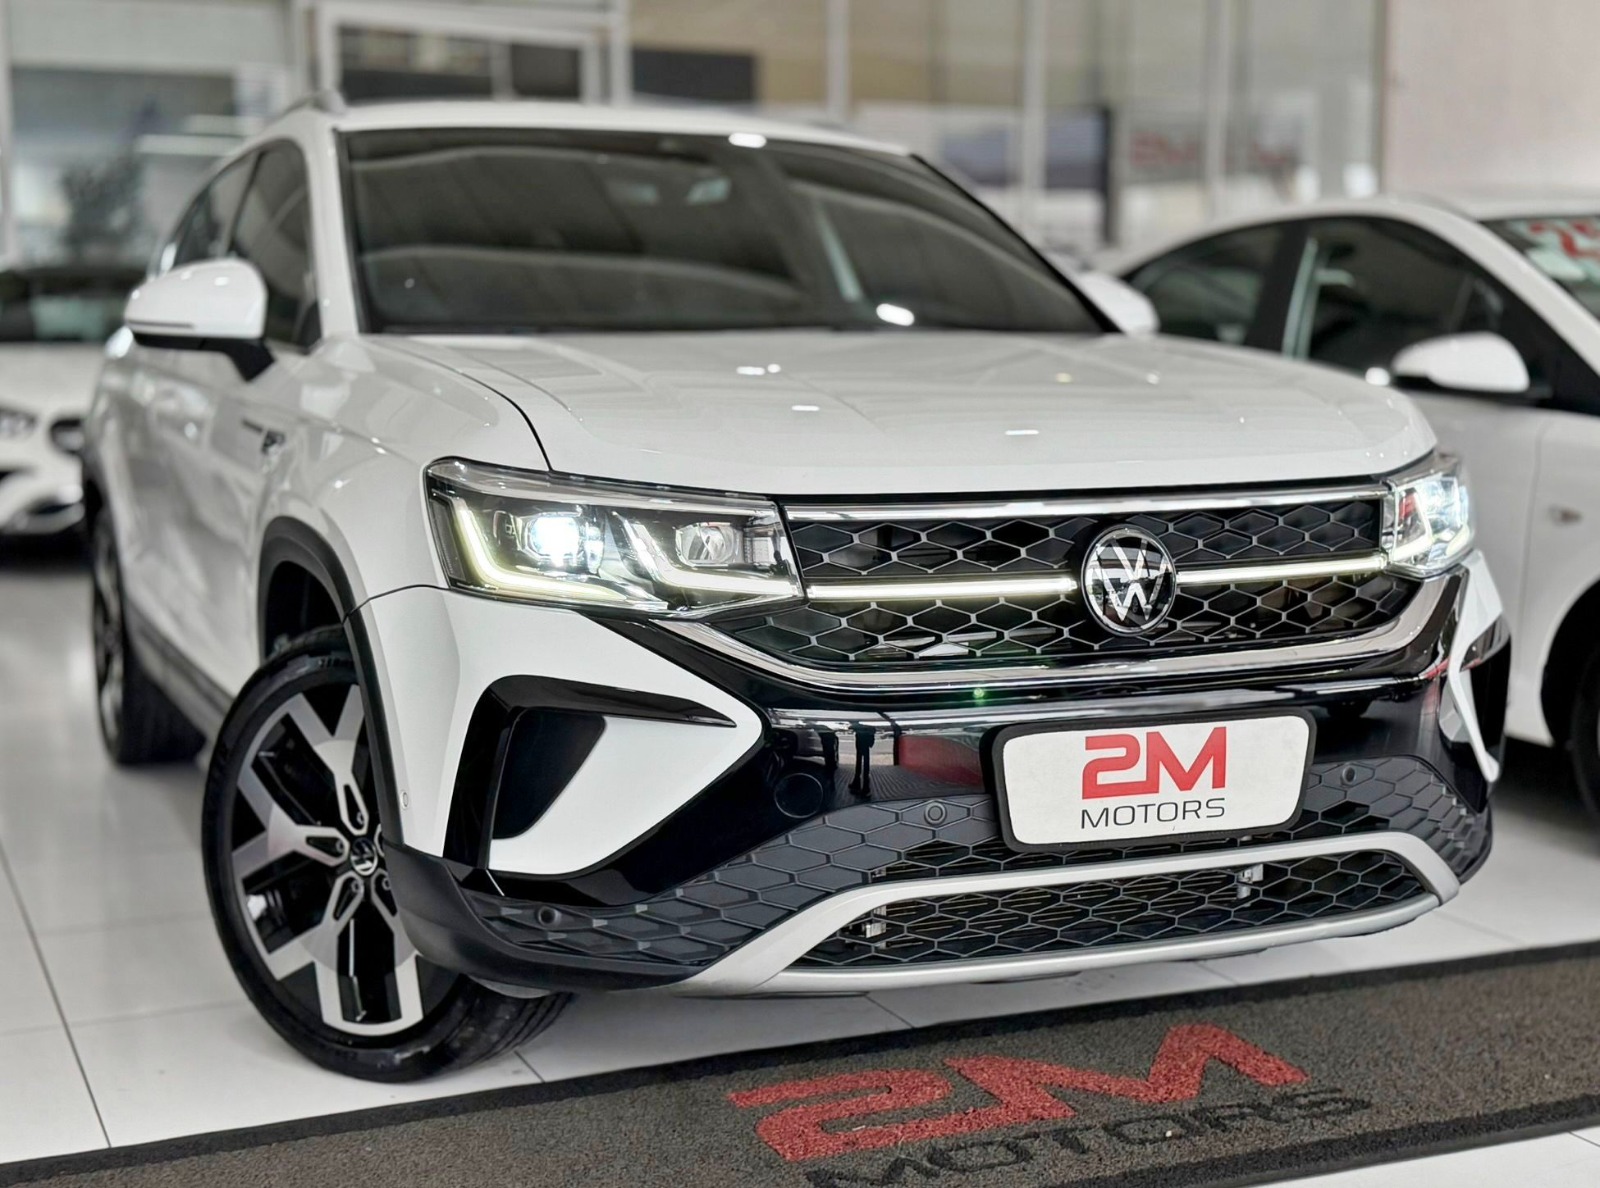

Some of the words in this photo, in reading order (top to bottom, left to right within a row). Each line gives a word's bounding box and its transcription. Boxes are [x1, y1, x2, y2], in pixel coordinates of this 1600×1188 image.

[1081, 726, 1227, 800] 2M
[1081, 797, 1226, 830] MOTORS
[727, 1023, 1309, 1162] 2M
[806, 1087, 1372, 1188] MOTORS
